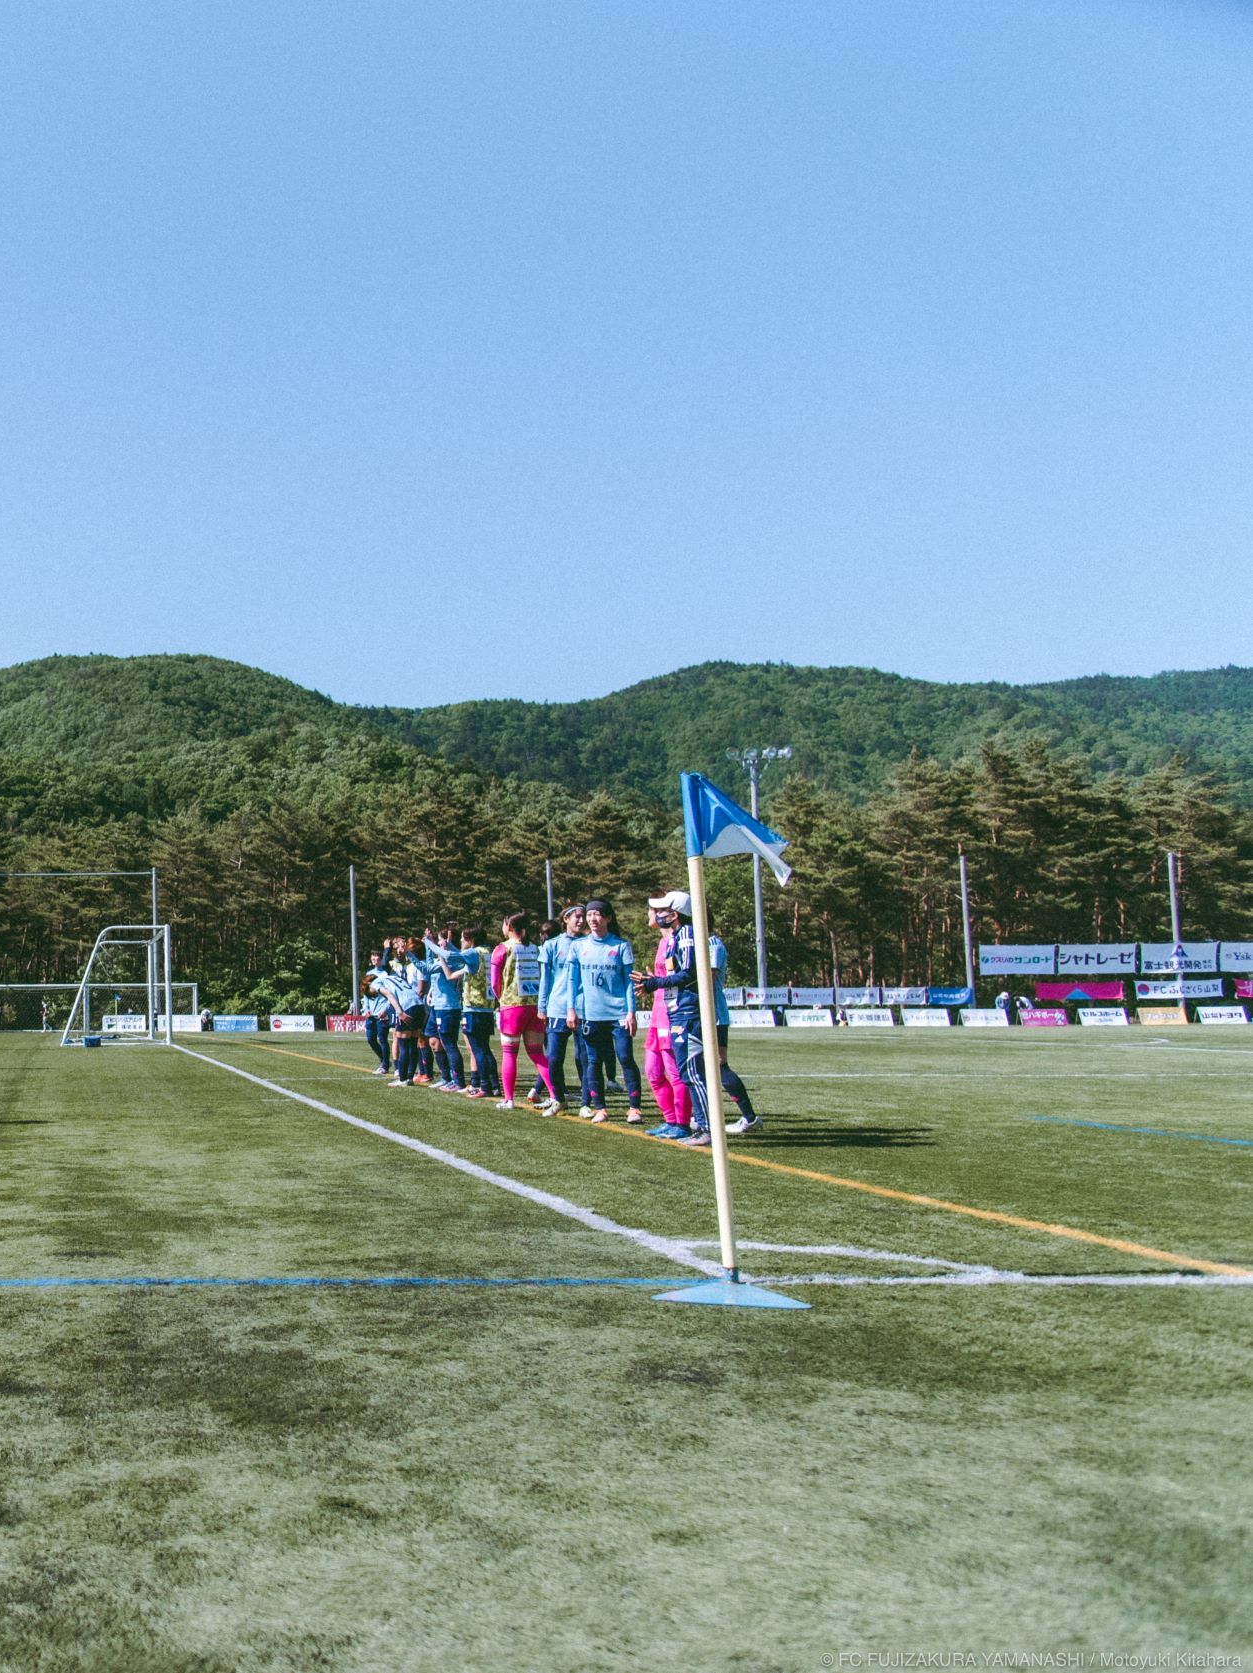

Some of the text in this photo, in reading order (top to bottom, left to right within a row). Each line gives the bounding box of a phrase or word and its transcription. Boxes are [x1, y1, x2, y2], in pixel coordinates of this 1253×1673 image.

[1059, 952, 1134, 966] シャトレーゼ
[1144, 960, 1202, 970] 富士観光開発
[591, 972, 604, 988] 16
